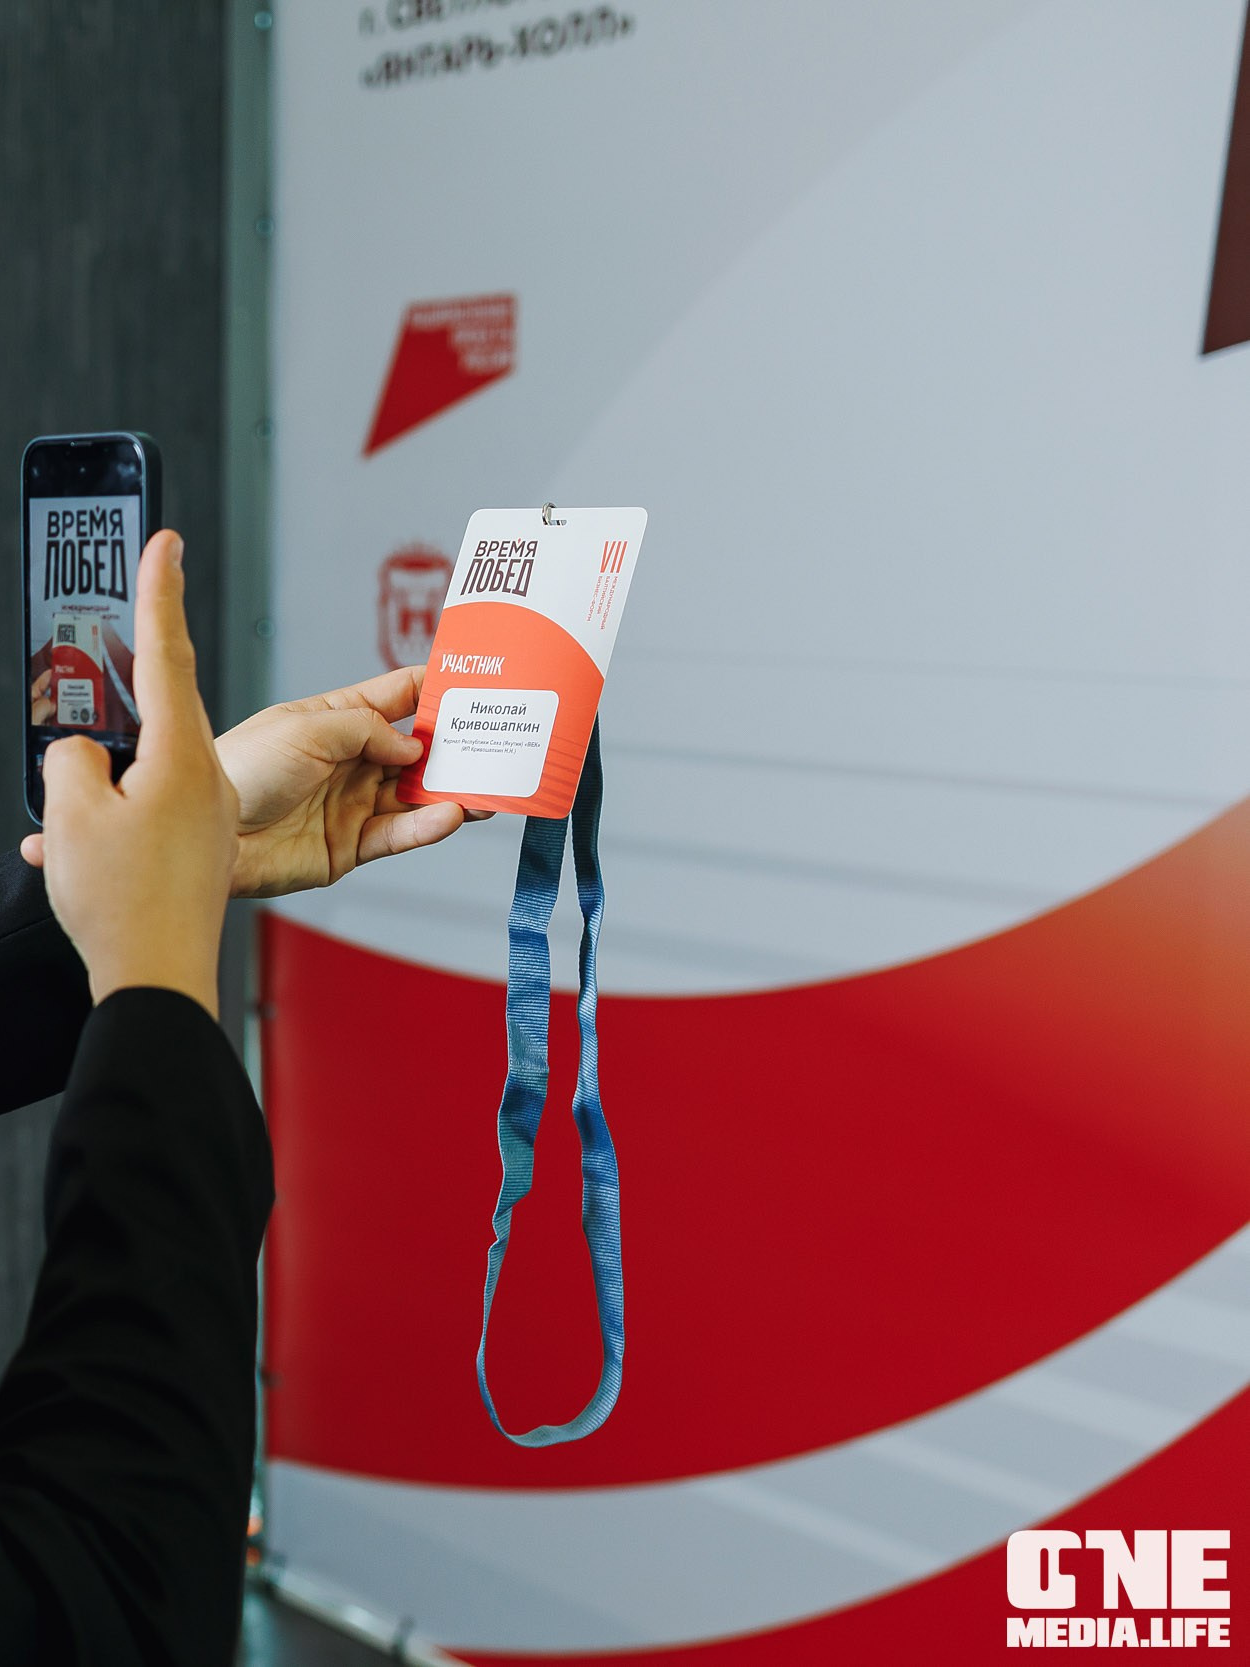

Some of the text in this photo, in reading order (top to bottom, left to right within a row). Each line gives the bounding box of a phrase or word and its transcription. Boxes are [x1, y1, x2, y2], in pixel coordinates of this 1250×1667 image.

[47, 507, 124, 538] ВРЕМЯ
[474, 539, 538, 558] ВРЕМЯ
[600, 541, 628, 573] VII
[44, 539, 128, 602] ПОБЕД
[460, 558, 534, 598] ПОБЕД
[440, 654, 505, 676] УЧАСТНИК
[470, 701, 527, 716] Николай
[450, 717, 540, 734] Кривошапкин
